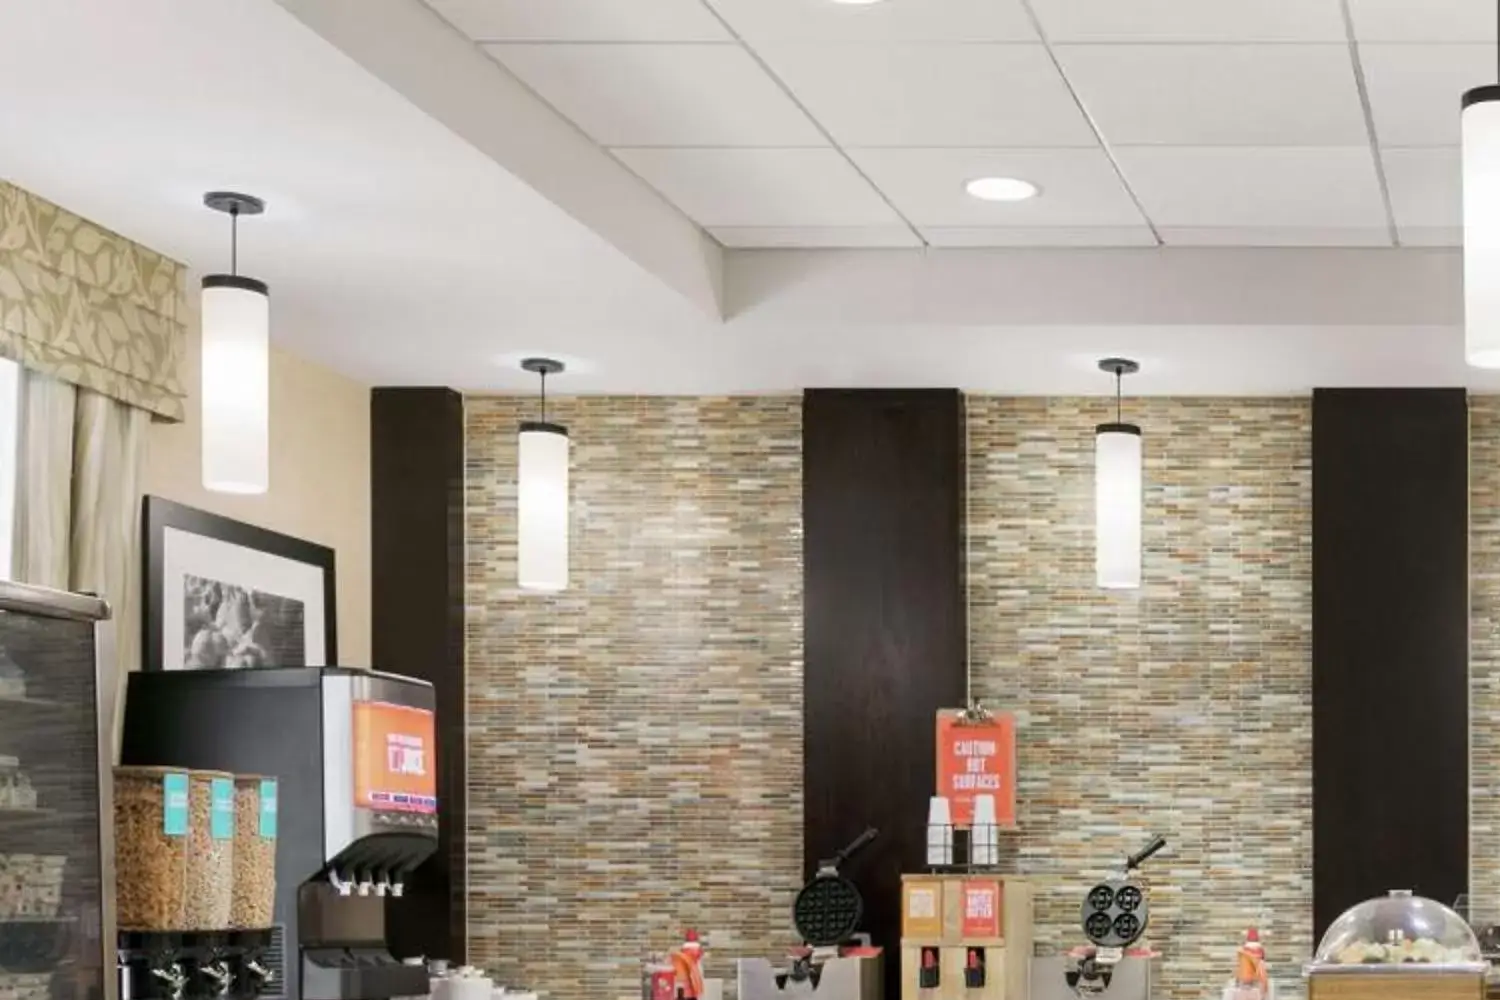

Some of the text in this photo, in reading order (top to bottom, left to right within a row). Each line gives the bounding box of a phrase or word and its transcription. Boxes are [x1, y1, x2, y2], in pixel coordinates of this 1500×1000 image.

[953, 740, 996, 757] CAUTION
[967, 757, 986, 773] HOT
[952, 773, 1001, 790] SURFACES
